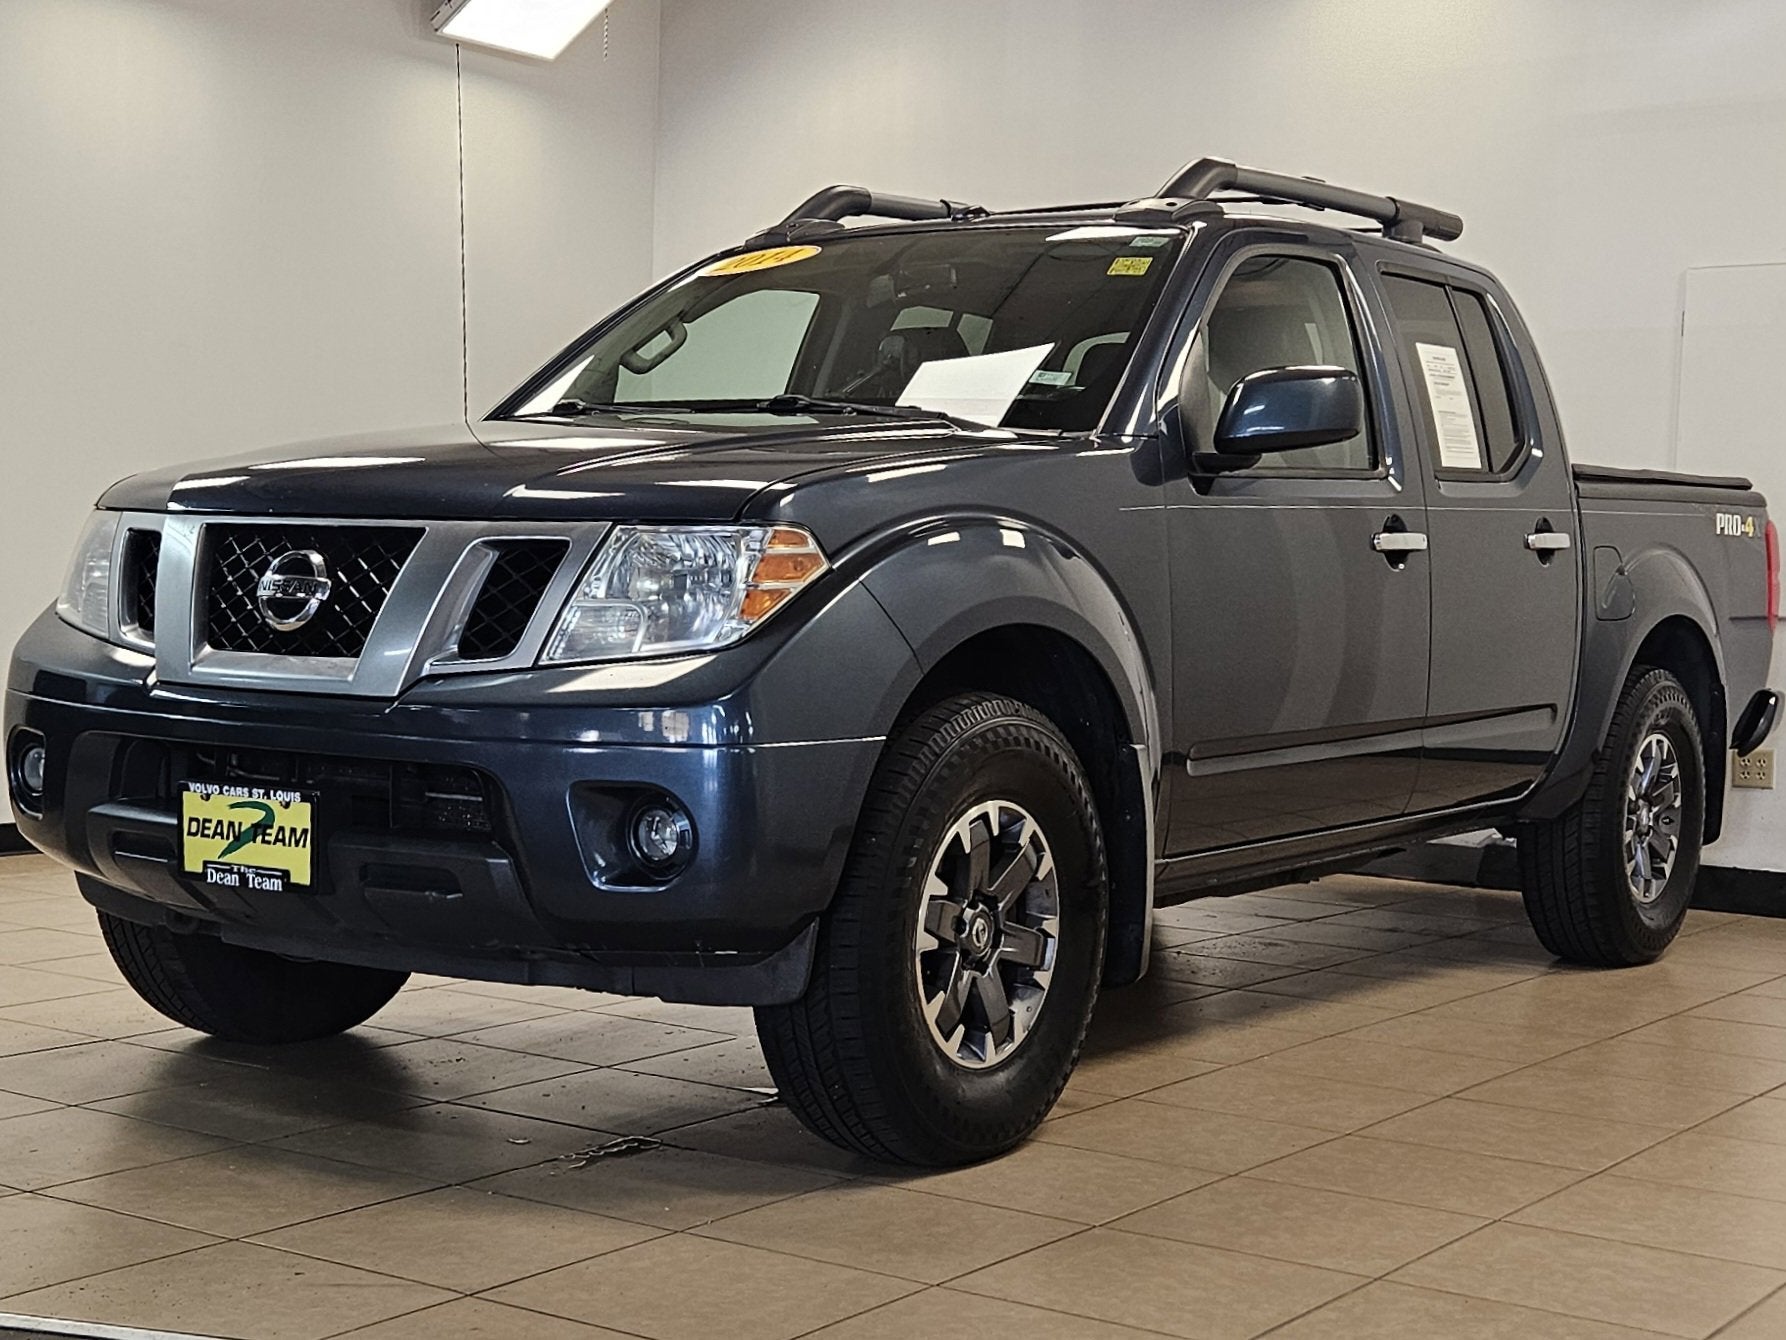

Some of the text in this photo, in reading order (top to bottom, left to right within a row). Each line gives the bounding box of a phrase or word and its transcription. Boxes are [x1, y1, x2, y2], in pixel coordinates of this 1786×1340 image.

[188, 782, 301, 803] VOLVO CARS ST. LOUIS
[186, 816, 309, 849] DEAN TEAM
[206, 868, 283, 892] Dean Team
[231, 865, 256, 874] The
